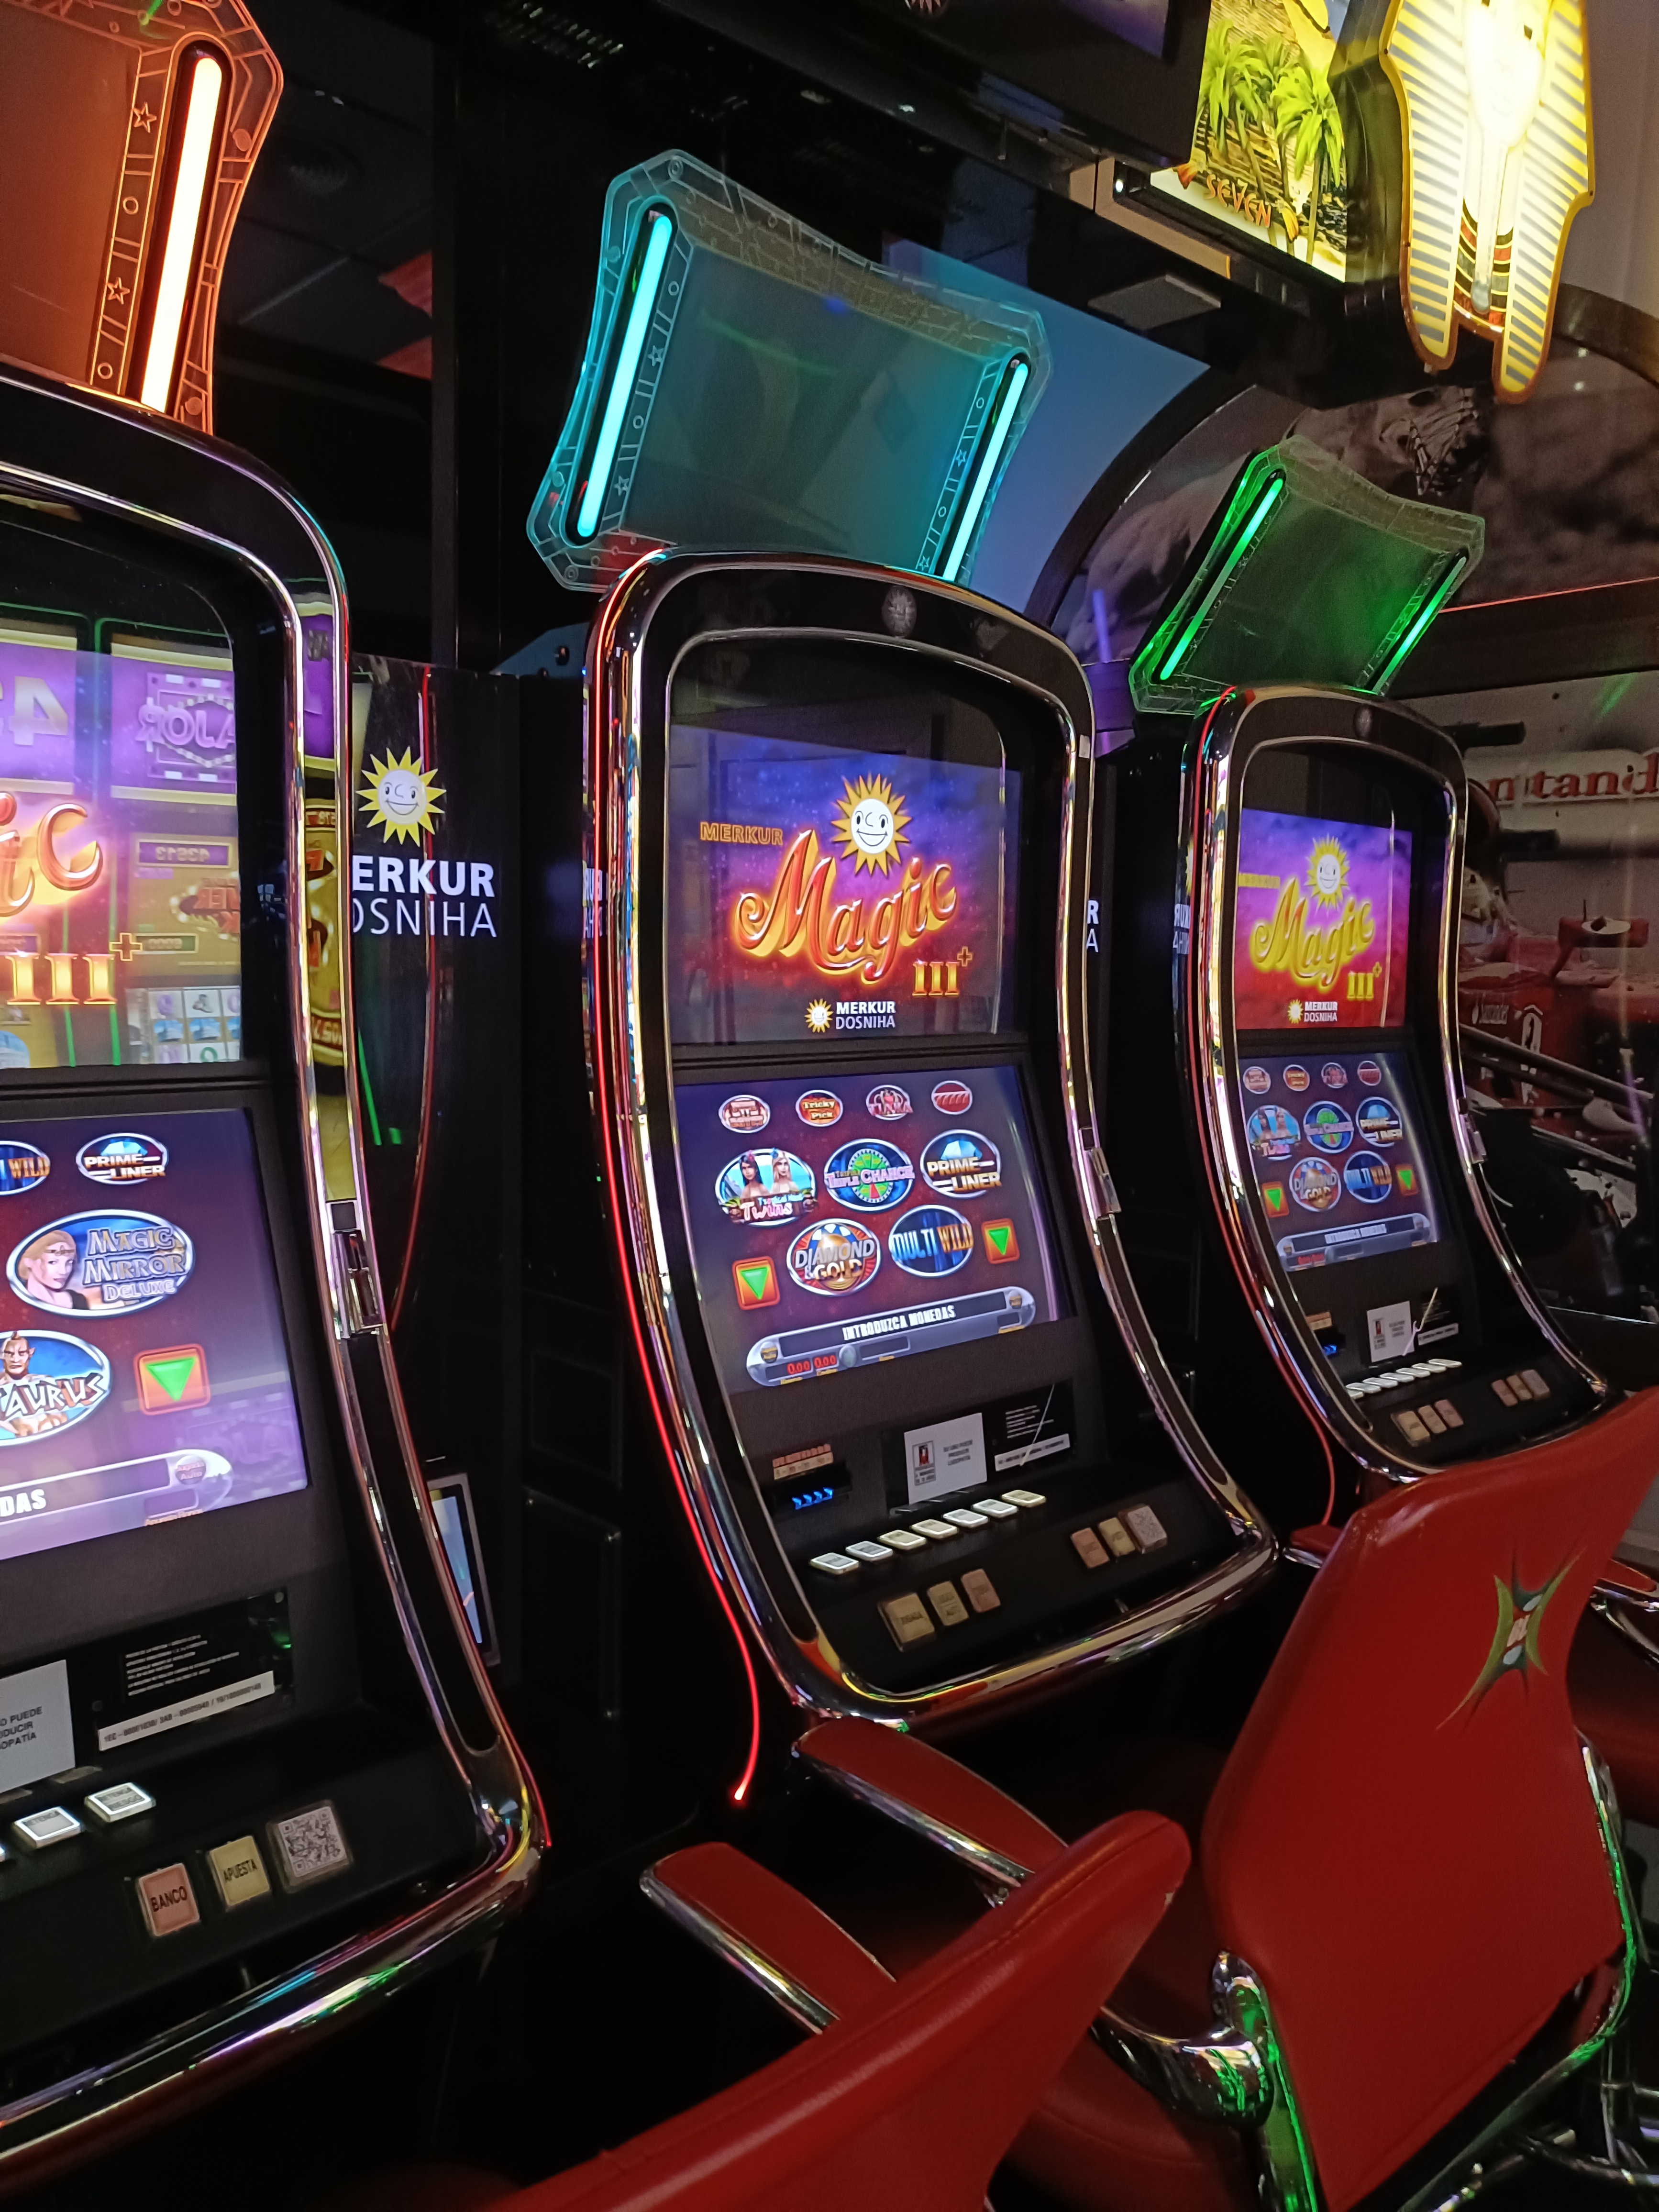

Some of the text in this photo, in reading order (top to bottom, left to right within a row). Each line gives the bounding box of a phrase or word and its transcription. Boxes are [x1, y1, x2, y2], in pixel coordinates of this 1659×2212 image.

[1204, 174, 1272, 228] SEVEN
[700, 821, 783, 845] MERKUR
[352, 855, 495, 897] ERKUR
[735, 830, 956, 984] Magic
[1250, 876, 1374, 990] Magic
[836, 1001, 896, 1015] MERKUR
[1304, 1012, 1338, 1022] DOSNIHA
[1305, 1001, 1338, 1011] MERKUR
[836, 1016, 896, 1029] DOSNIHA
[8, 1157, 50, 1179] WILD
[84, 1154, 144, 1168] PRIME
[927, 1157, 981, 1177] PRIME
[111, 1165, 166, 1180] LINER
[860, 1165, 915, 1183] CHANCE
[951, 1172, 1002, 1192] LINER
[740, 1202, 793, 1221] Twins
[87, 1228, 174, 1255] MAGIC
[891, 1224, 973, 1261] MULTI WILD
[795, 1239, 876, 1269] DIAMOND
[83, 1254, 186, 1285] MIRROR
[842, 1305, 956, 1341] INTRODUZCA MONEDAS
[786, 1360, 811, 1375] 0.00
[814, 1355, 836, 1368] 0.00
[10, 1706, 43, 1723] PUEDE
[223, 1858, 258, 1882] APUESTA
[151, 1886, 188, 1913] BANCO
